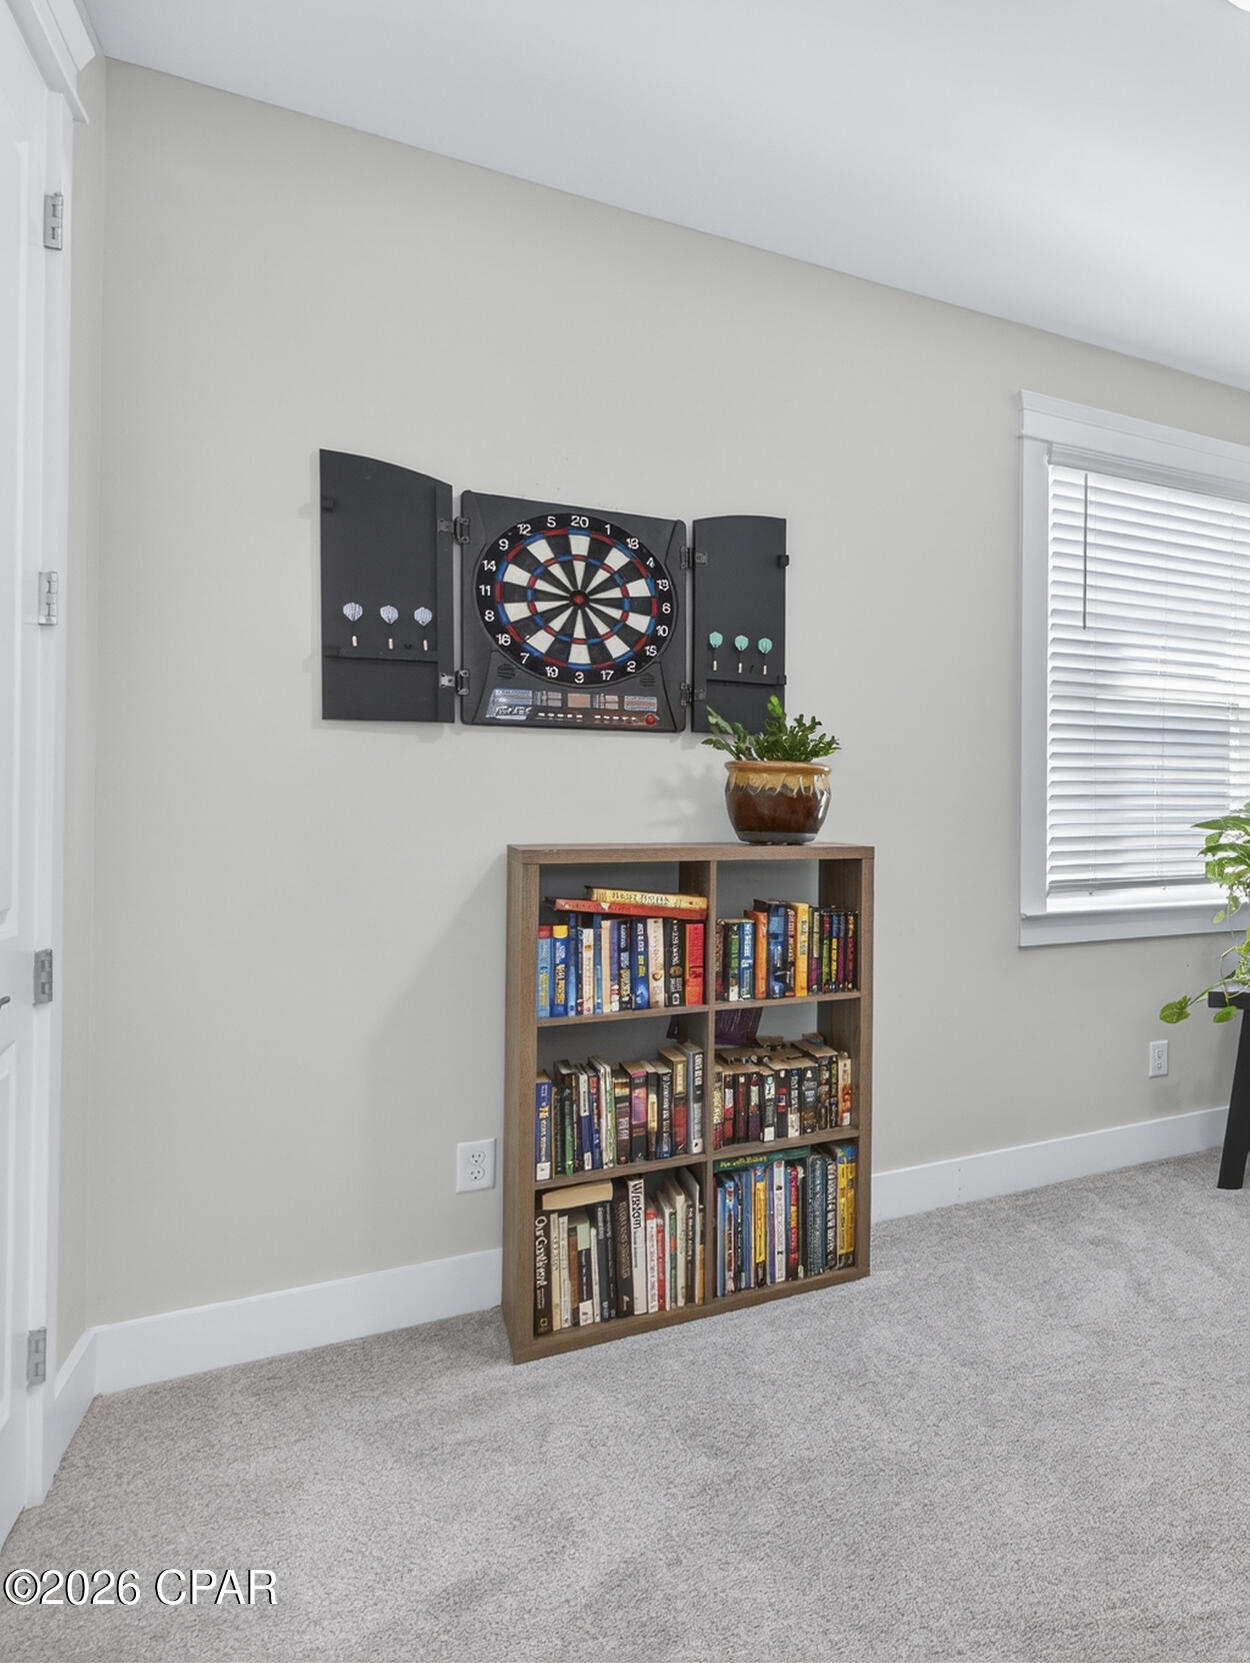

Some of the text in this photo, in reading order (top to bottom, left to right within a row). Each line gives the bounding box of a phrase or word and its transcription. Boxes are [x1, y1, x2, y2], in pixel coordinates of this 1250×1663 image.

[547, 516, 556, 528] 5
[570, 515, 590, 529] 20
[517, 523, 532, 537] 12
[604, 524, 611, 536] 1
[499, 539, 509, 551] 9
[482, 558, 497, 573] 14
[479, 585, 491, 596] 11
[662, 602, 671, 614] 6
[484, 610, 495, 622] 8
[656, 625, 669, 637] 10
[644, 645, 658, 657] 15
[520, 652, 529, 664] 7
[627, 660, 637, 673] 2
[574, 672, 585, 684] 3
[600, 669, 614, 682] 17
